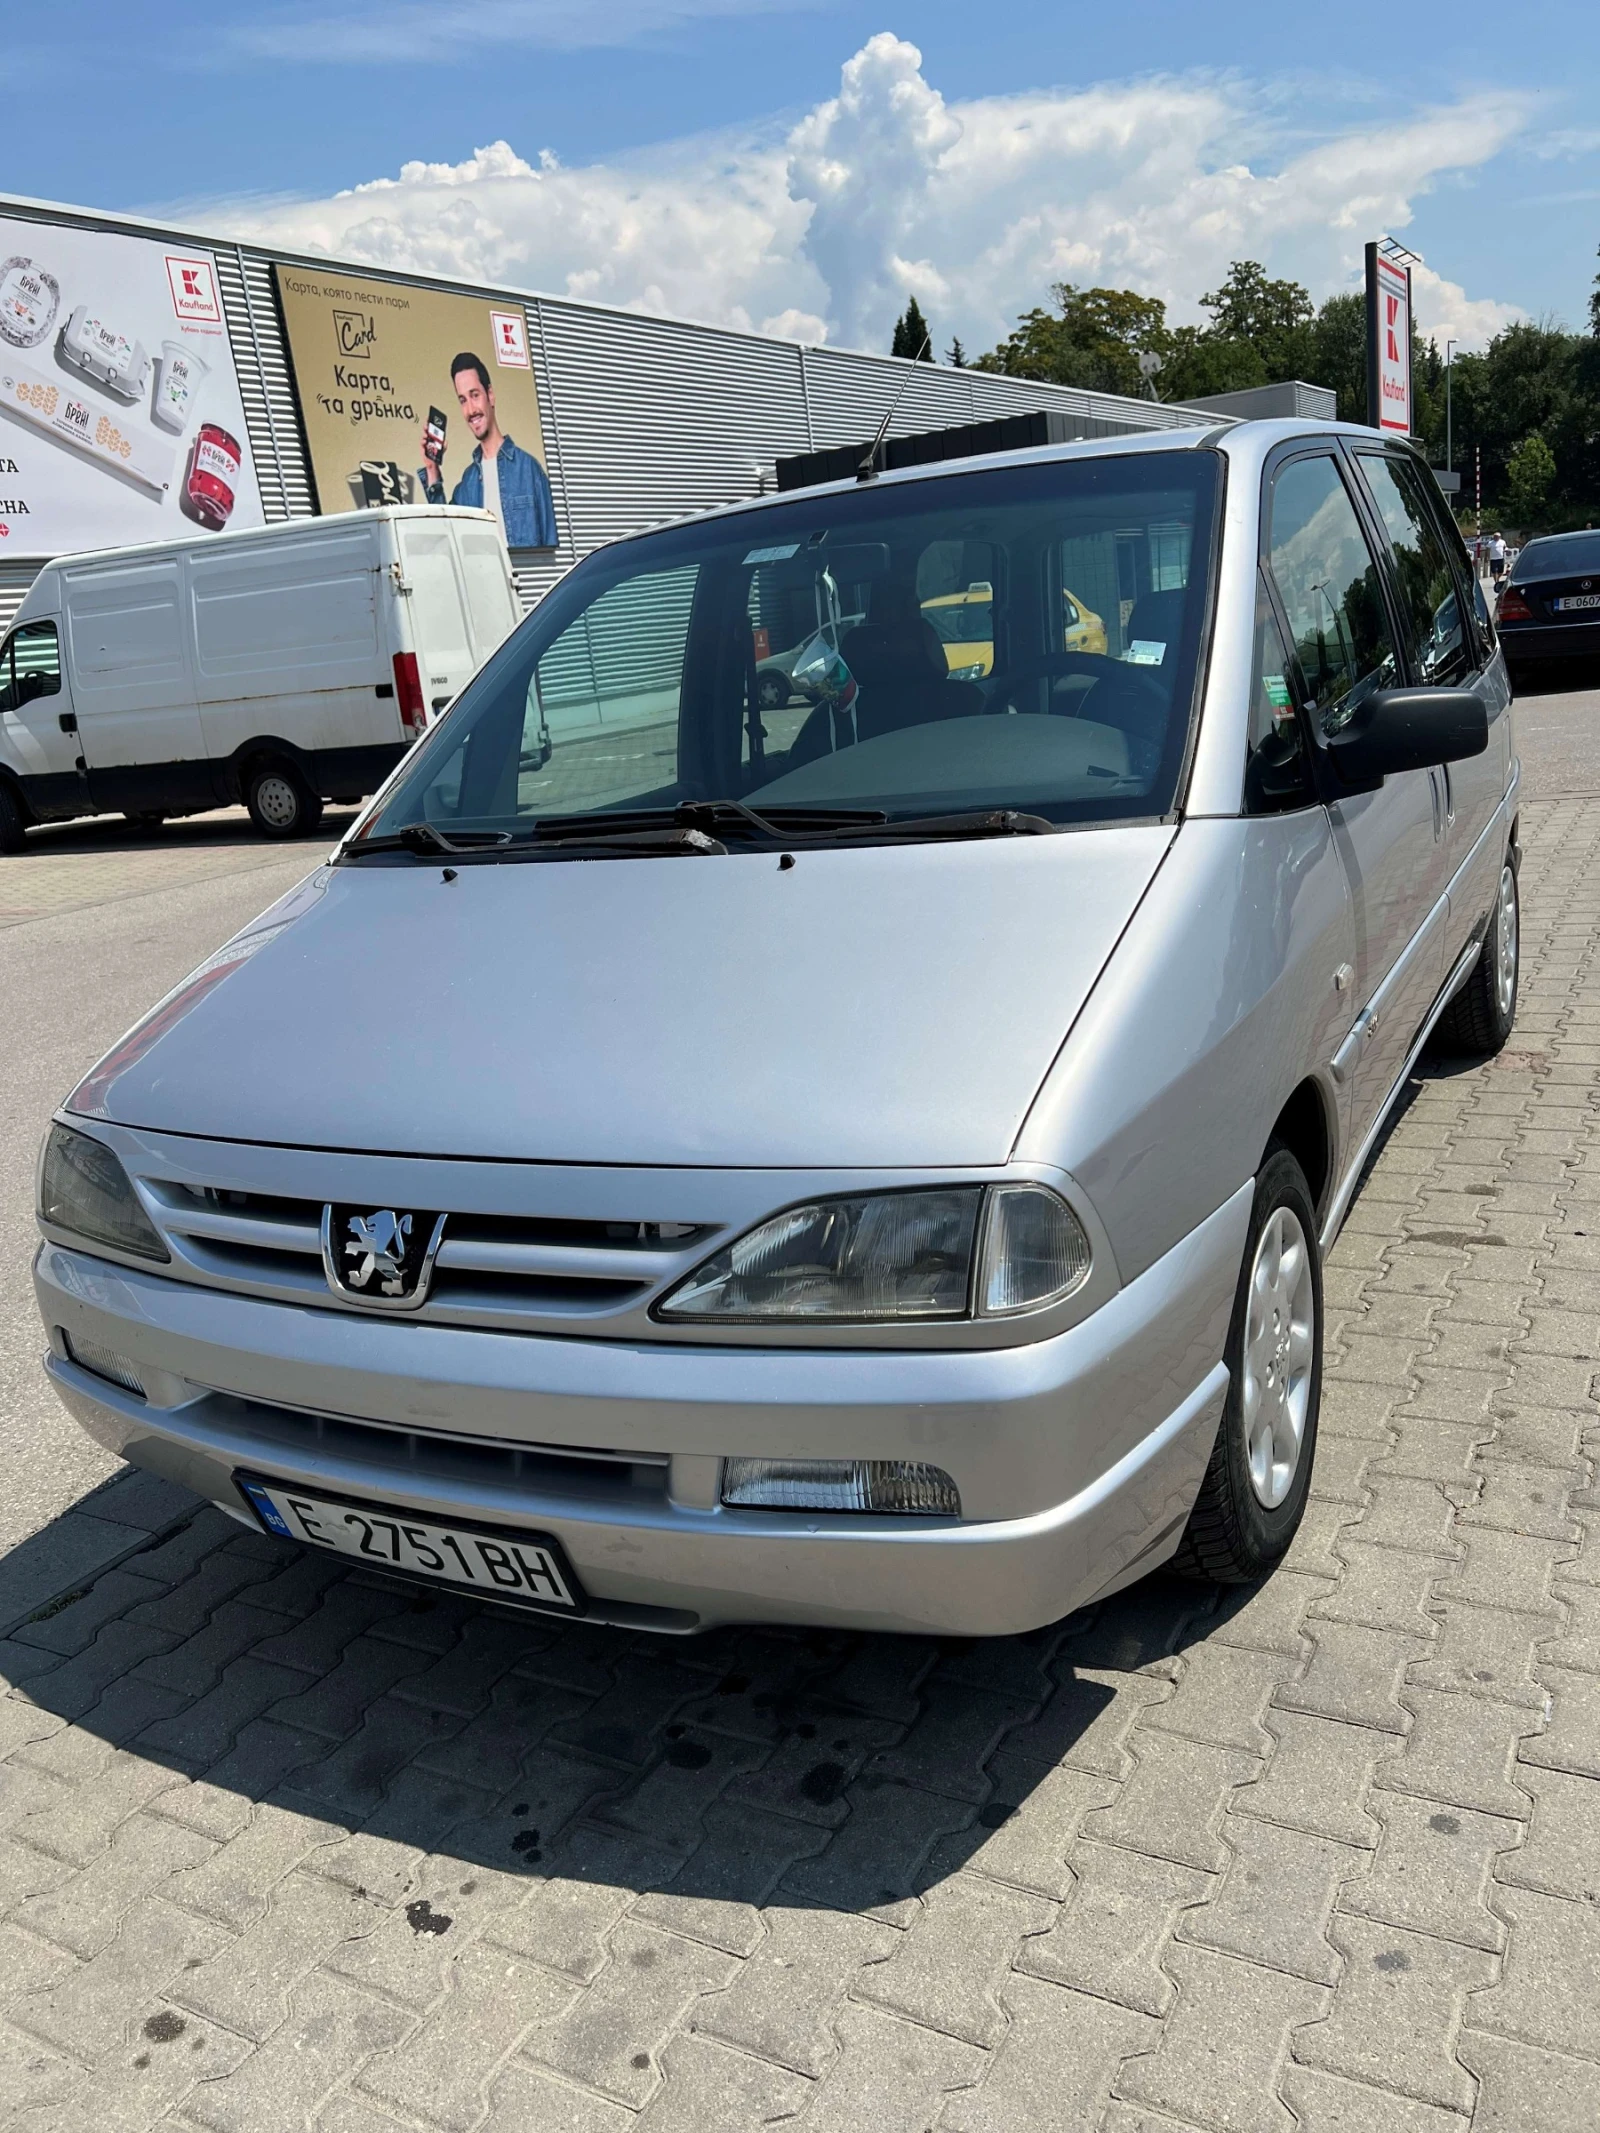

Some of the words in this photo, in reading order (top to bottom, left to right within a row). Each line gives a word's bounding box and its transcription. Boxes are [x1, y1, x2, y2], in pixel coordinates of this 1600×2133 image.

[179, 298, 213, 311] Kaufland
[285, 277, 320, 297] Карта,
[323, 286, 352, 300] която
[354, 291, 384, 304] пести
[385, 296, 410, 310] пари
[341, 316, 378, 351] Card
[500, 348, 524, 358] Kaufland
[334, 364, 394, 395] Карта,
[1382, 373, 1405, 402] Kaufland
[322, 398, 344, 414] та
[351, 399, 414, 421] дрънка
[1576, 595, 1600, 607] 0607
[265, 1512, 285, 1529] BG
[286, 1498, 336, 1546] E
